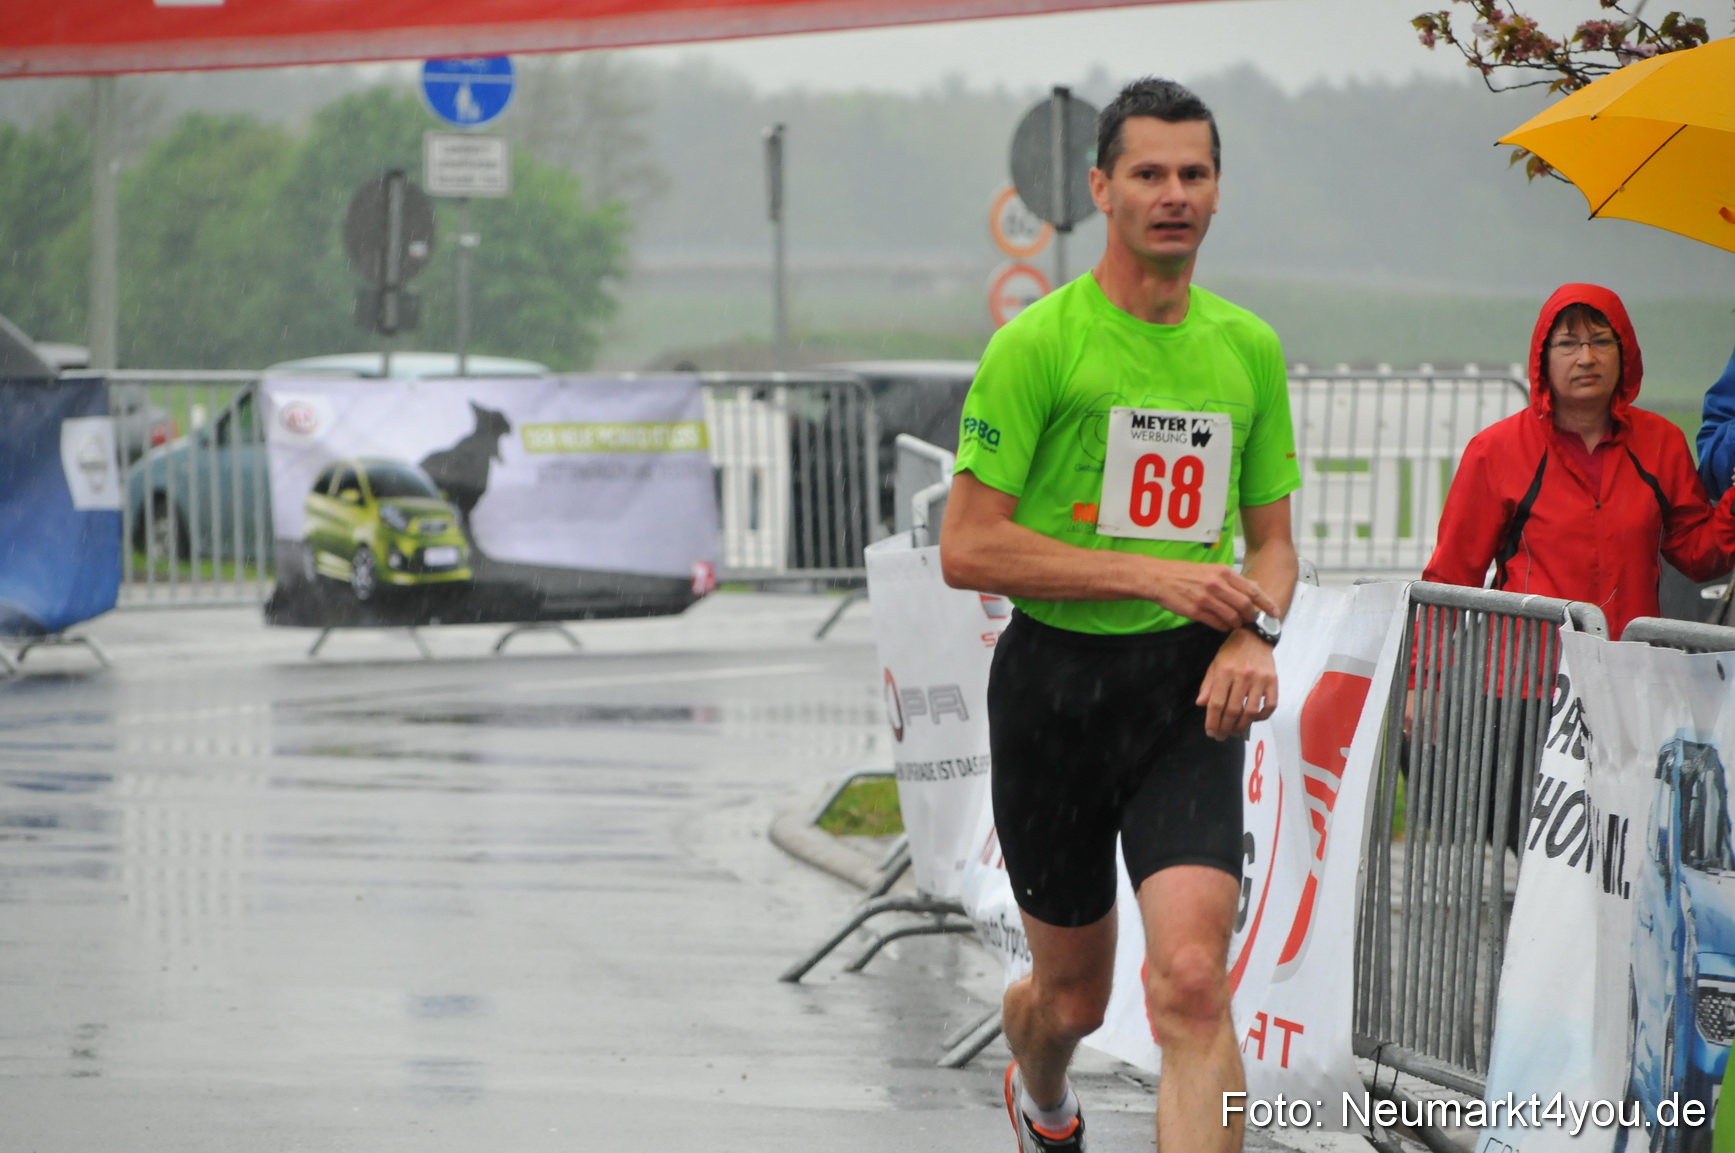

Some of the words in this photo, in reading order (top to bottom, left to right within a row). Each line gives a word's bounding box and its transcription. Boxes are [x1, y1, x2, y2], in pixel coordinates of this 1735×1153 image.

[1131, 414, 1187, 432] MEYER
[1131, 430, 1188, 444] WERBUNG
[1128, 452, 1205, 530] 68
[980, 630, 1004, 648] S
